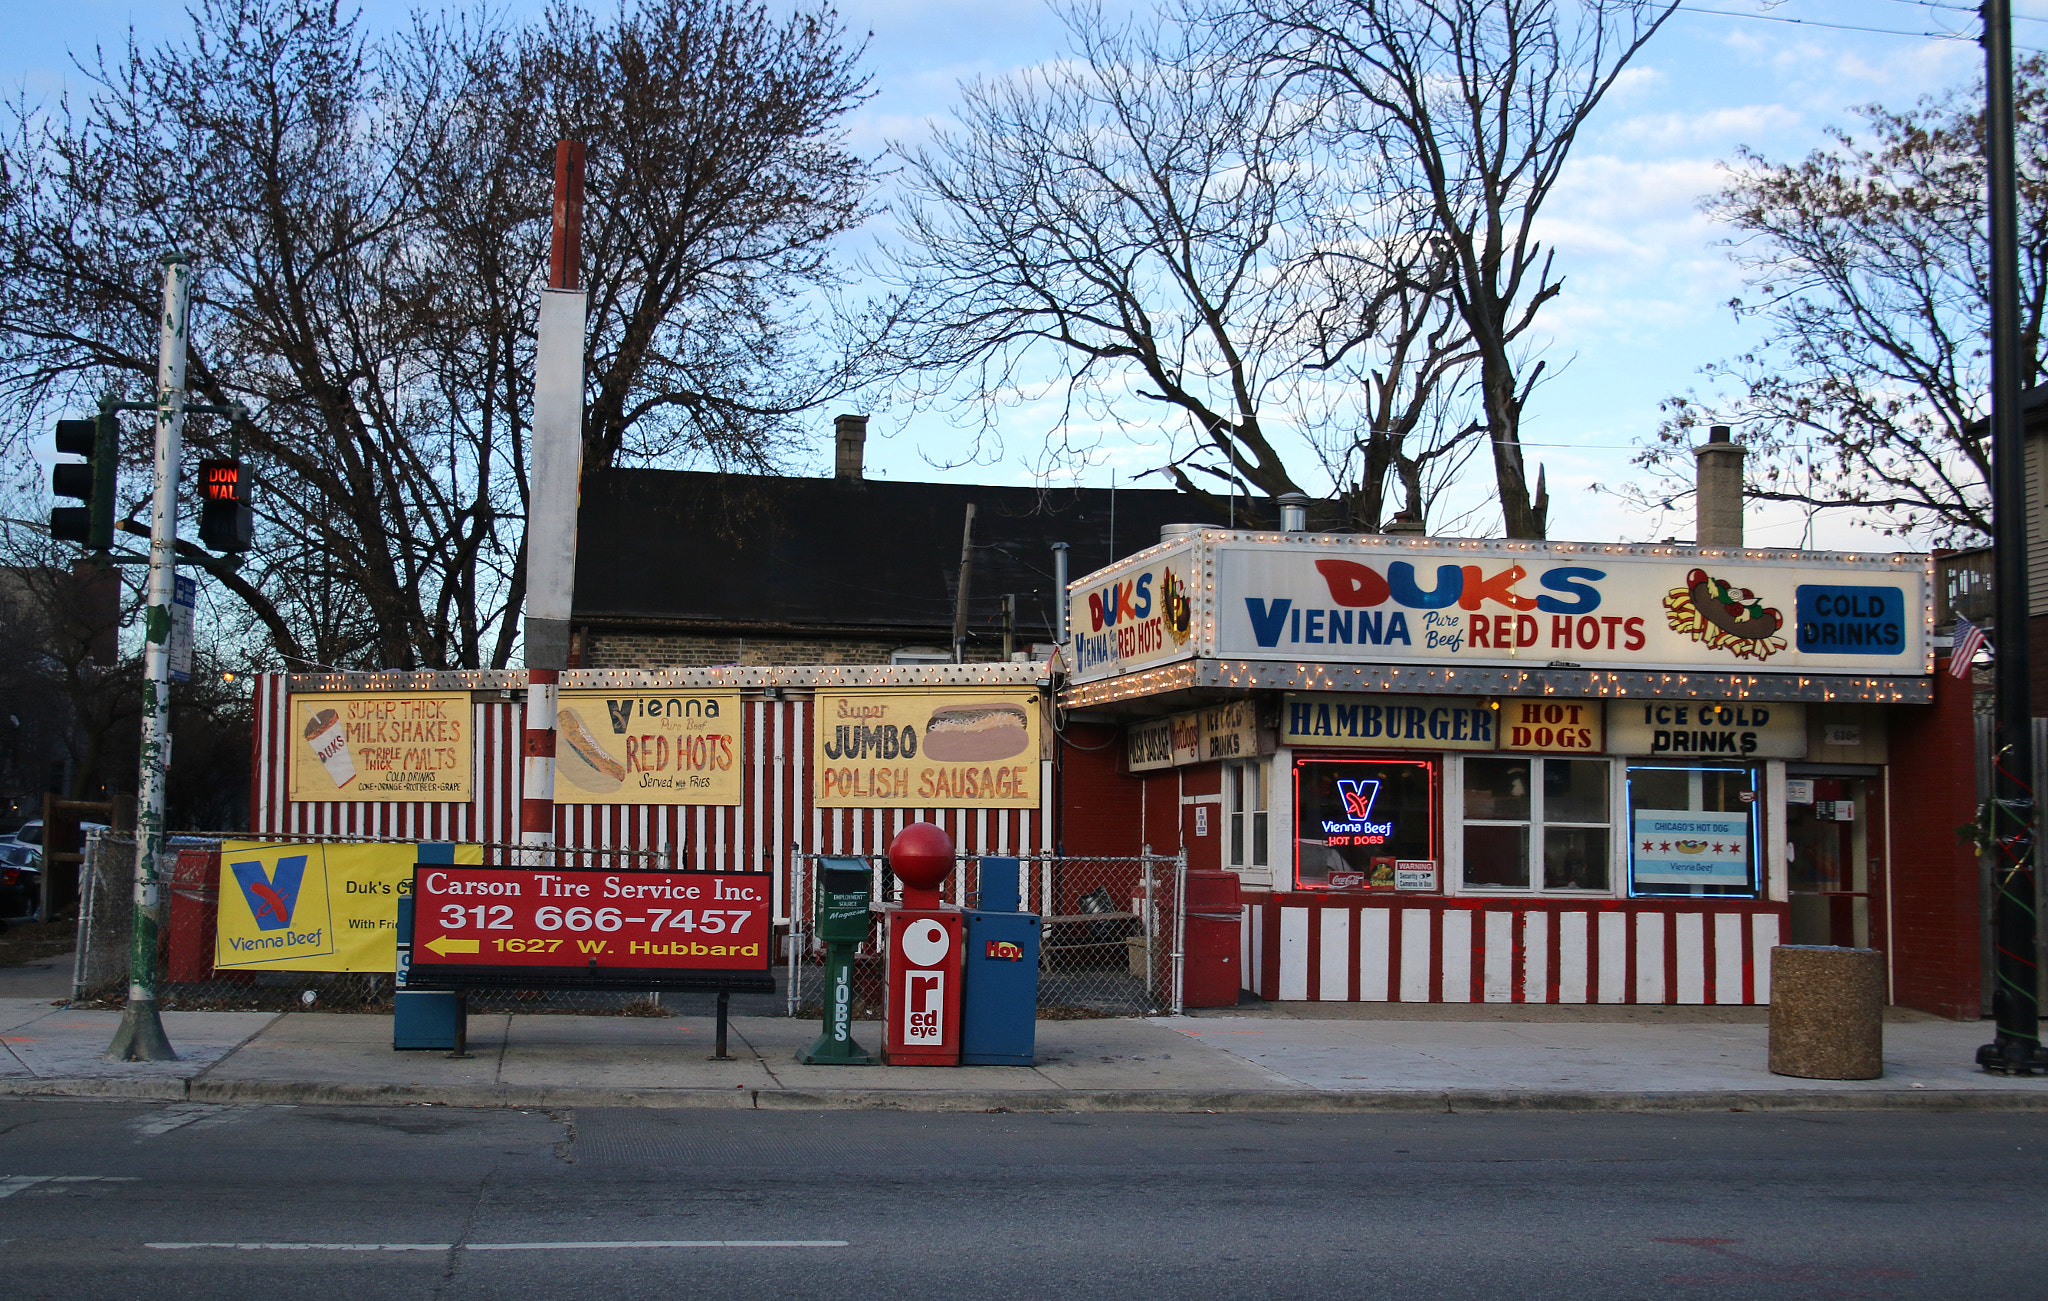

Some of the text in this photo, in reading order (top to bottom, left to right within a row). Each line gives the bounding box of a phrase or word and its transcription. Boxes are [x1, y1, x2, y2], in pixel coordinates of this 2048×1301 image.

[1314, 559, 1606, 614] DUKS
[1088, 572, 1153, 633] DUKS
[1816, 594, 1885, 618] COLD
[1244, 597, 1646, 650] VIENNA Pure RED HOTS
[1803, 622, 1899, 646] DRINKS
[1075, 616, 1162, 673] VIENNA RED HOTS
[1425, 629, 1464, 652] Beef
[347, 701, 447, 720] SUPER THICK
[607, 699, 720, 734] Vienna
[836, 698, 889, 725] Super
[1207, 705, 1242, 732] ICE COLD
[1521, 703, 1583, 725] HOT
[1645, 704, 1770, 727] ICE COLD
[660, 718, 708, 732] Pure Beef
[1288, 703, 1492, 742] HAMBURGER
[317, 735, 345, 763] DUKS
[824, 724, 917, 760] JUMBO
[1209, 733, 1240, 758] DRINKS
[1511, 726, 1592, 749] DOGS
[1653, 730, 1758, 753] DRINKS
[403, 747, 457, 770] MALTS
[626, 734, 733, 774] RED HOTS
[377, 783, 403, 791] ORANGE
[440, 783, 461, 791] GRAPE
[386, 771, 436, 782] COLD DRINKS
[639, 772, 674, 788] Served
[690, 775, 711, 788] FRIES
[824, 766, 1029, 799] POLISH SAUSAGE
[1321, 820, 1392, 836] Vienna Beef
[1655, 822, 1729, 833] CHICAGO'S HOT DOG
[1328, 835, 1385, 846] HOT DOGS
[1669, 862, 1713, 873] Vienna Beef
[346, 880, 391, 894] Duk's
[426, 872, 762, 901] Carson Tire Service Inc.
[349, 919, 375, 929] With
[439, 904, 752, 934] 312 666-7457
[829, 909, 866, 920] Magazine
[229, 928, 323, 951] Vienna Beef
[492, 938, 759, 957] 1627 W. Hubbard
[986, 940, 1023, 962] Hoy
[834, 966, 848, 1042] JOBS
[910, 1025, 938, 1039] eye
